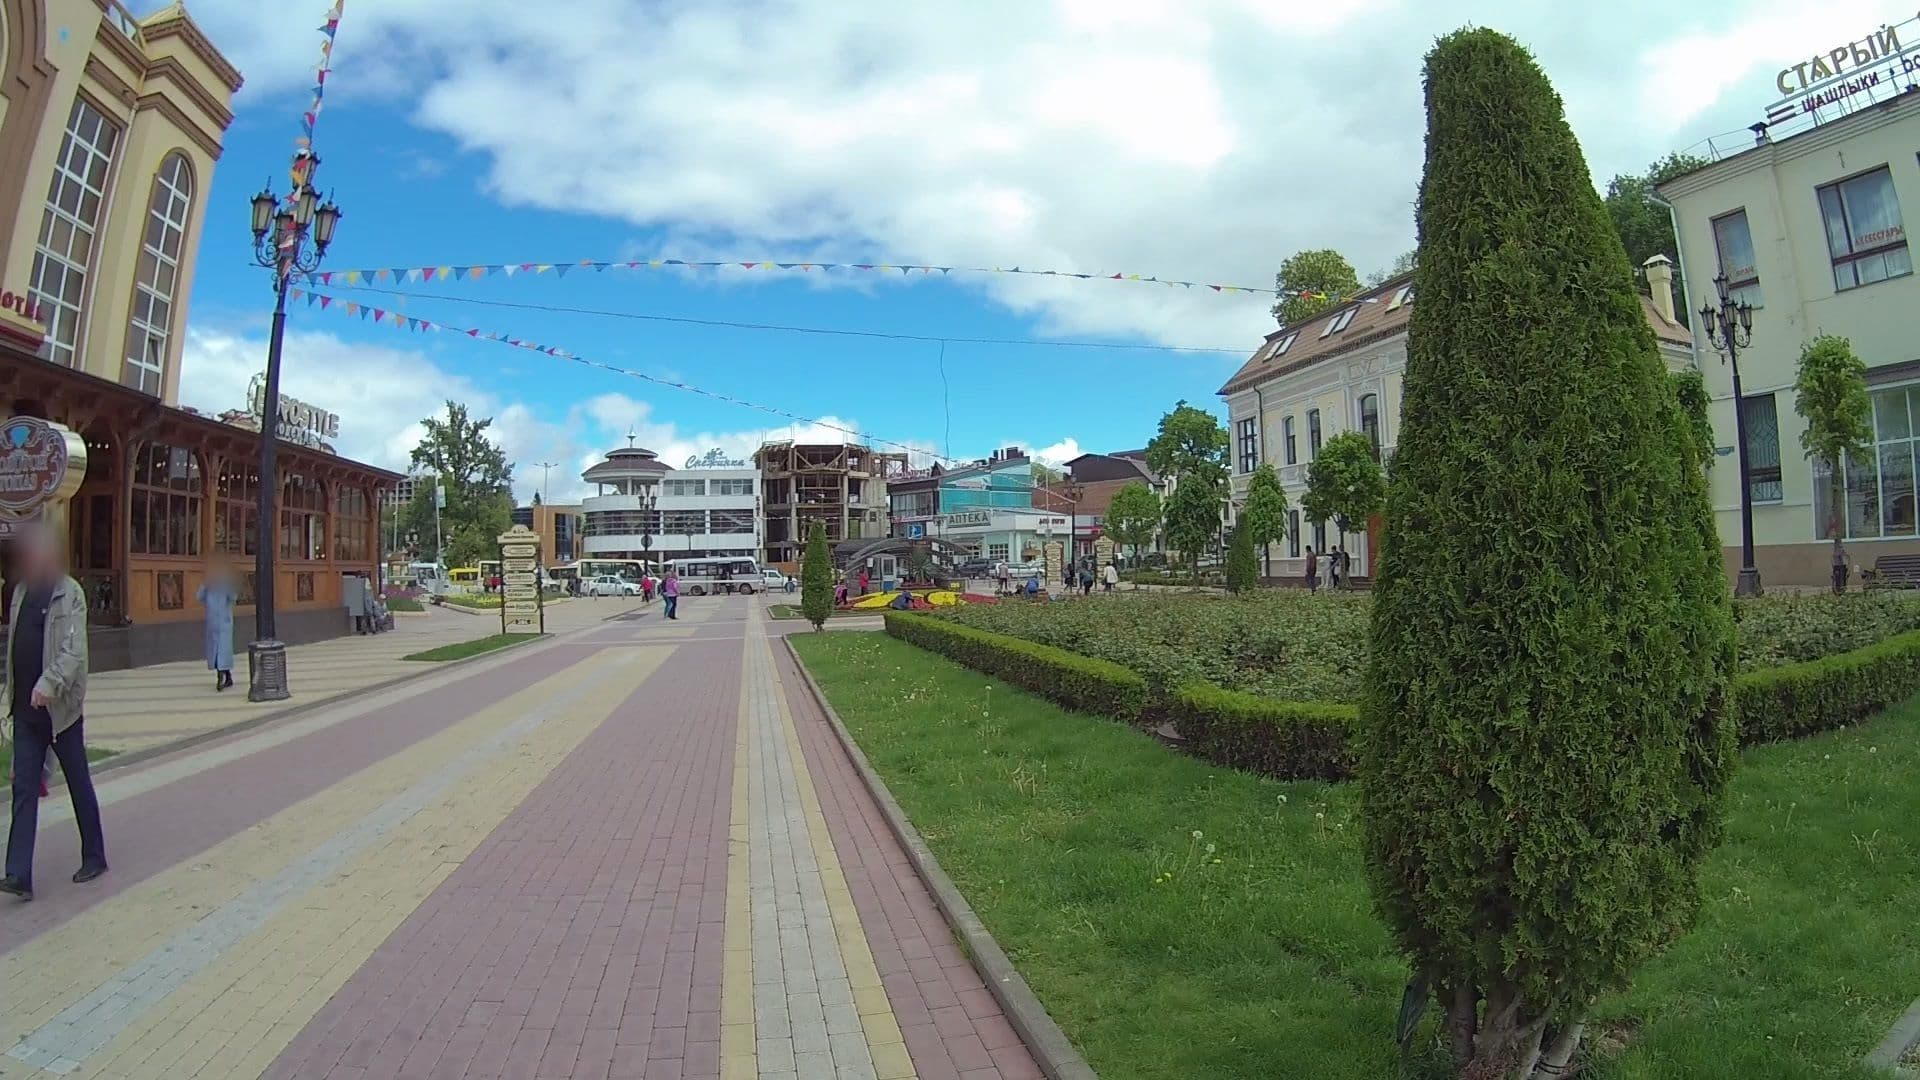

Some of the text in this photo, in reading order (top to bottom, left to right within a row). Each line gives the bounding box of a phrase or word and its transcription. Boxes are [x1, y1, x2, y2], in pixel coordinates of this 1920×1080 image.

[1777, 24, 1901, 95] СТАРЫЙ
[1801, 71, 1880, 112] ШАШЛЫКИ
[0, 288, 46, 321] OTEL
[949, 511, 989, 524] АПТЕКА
